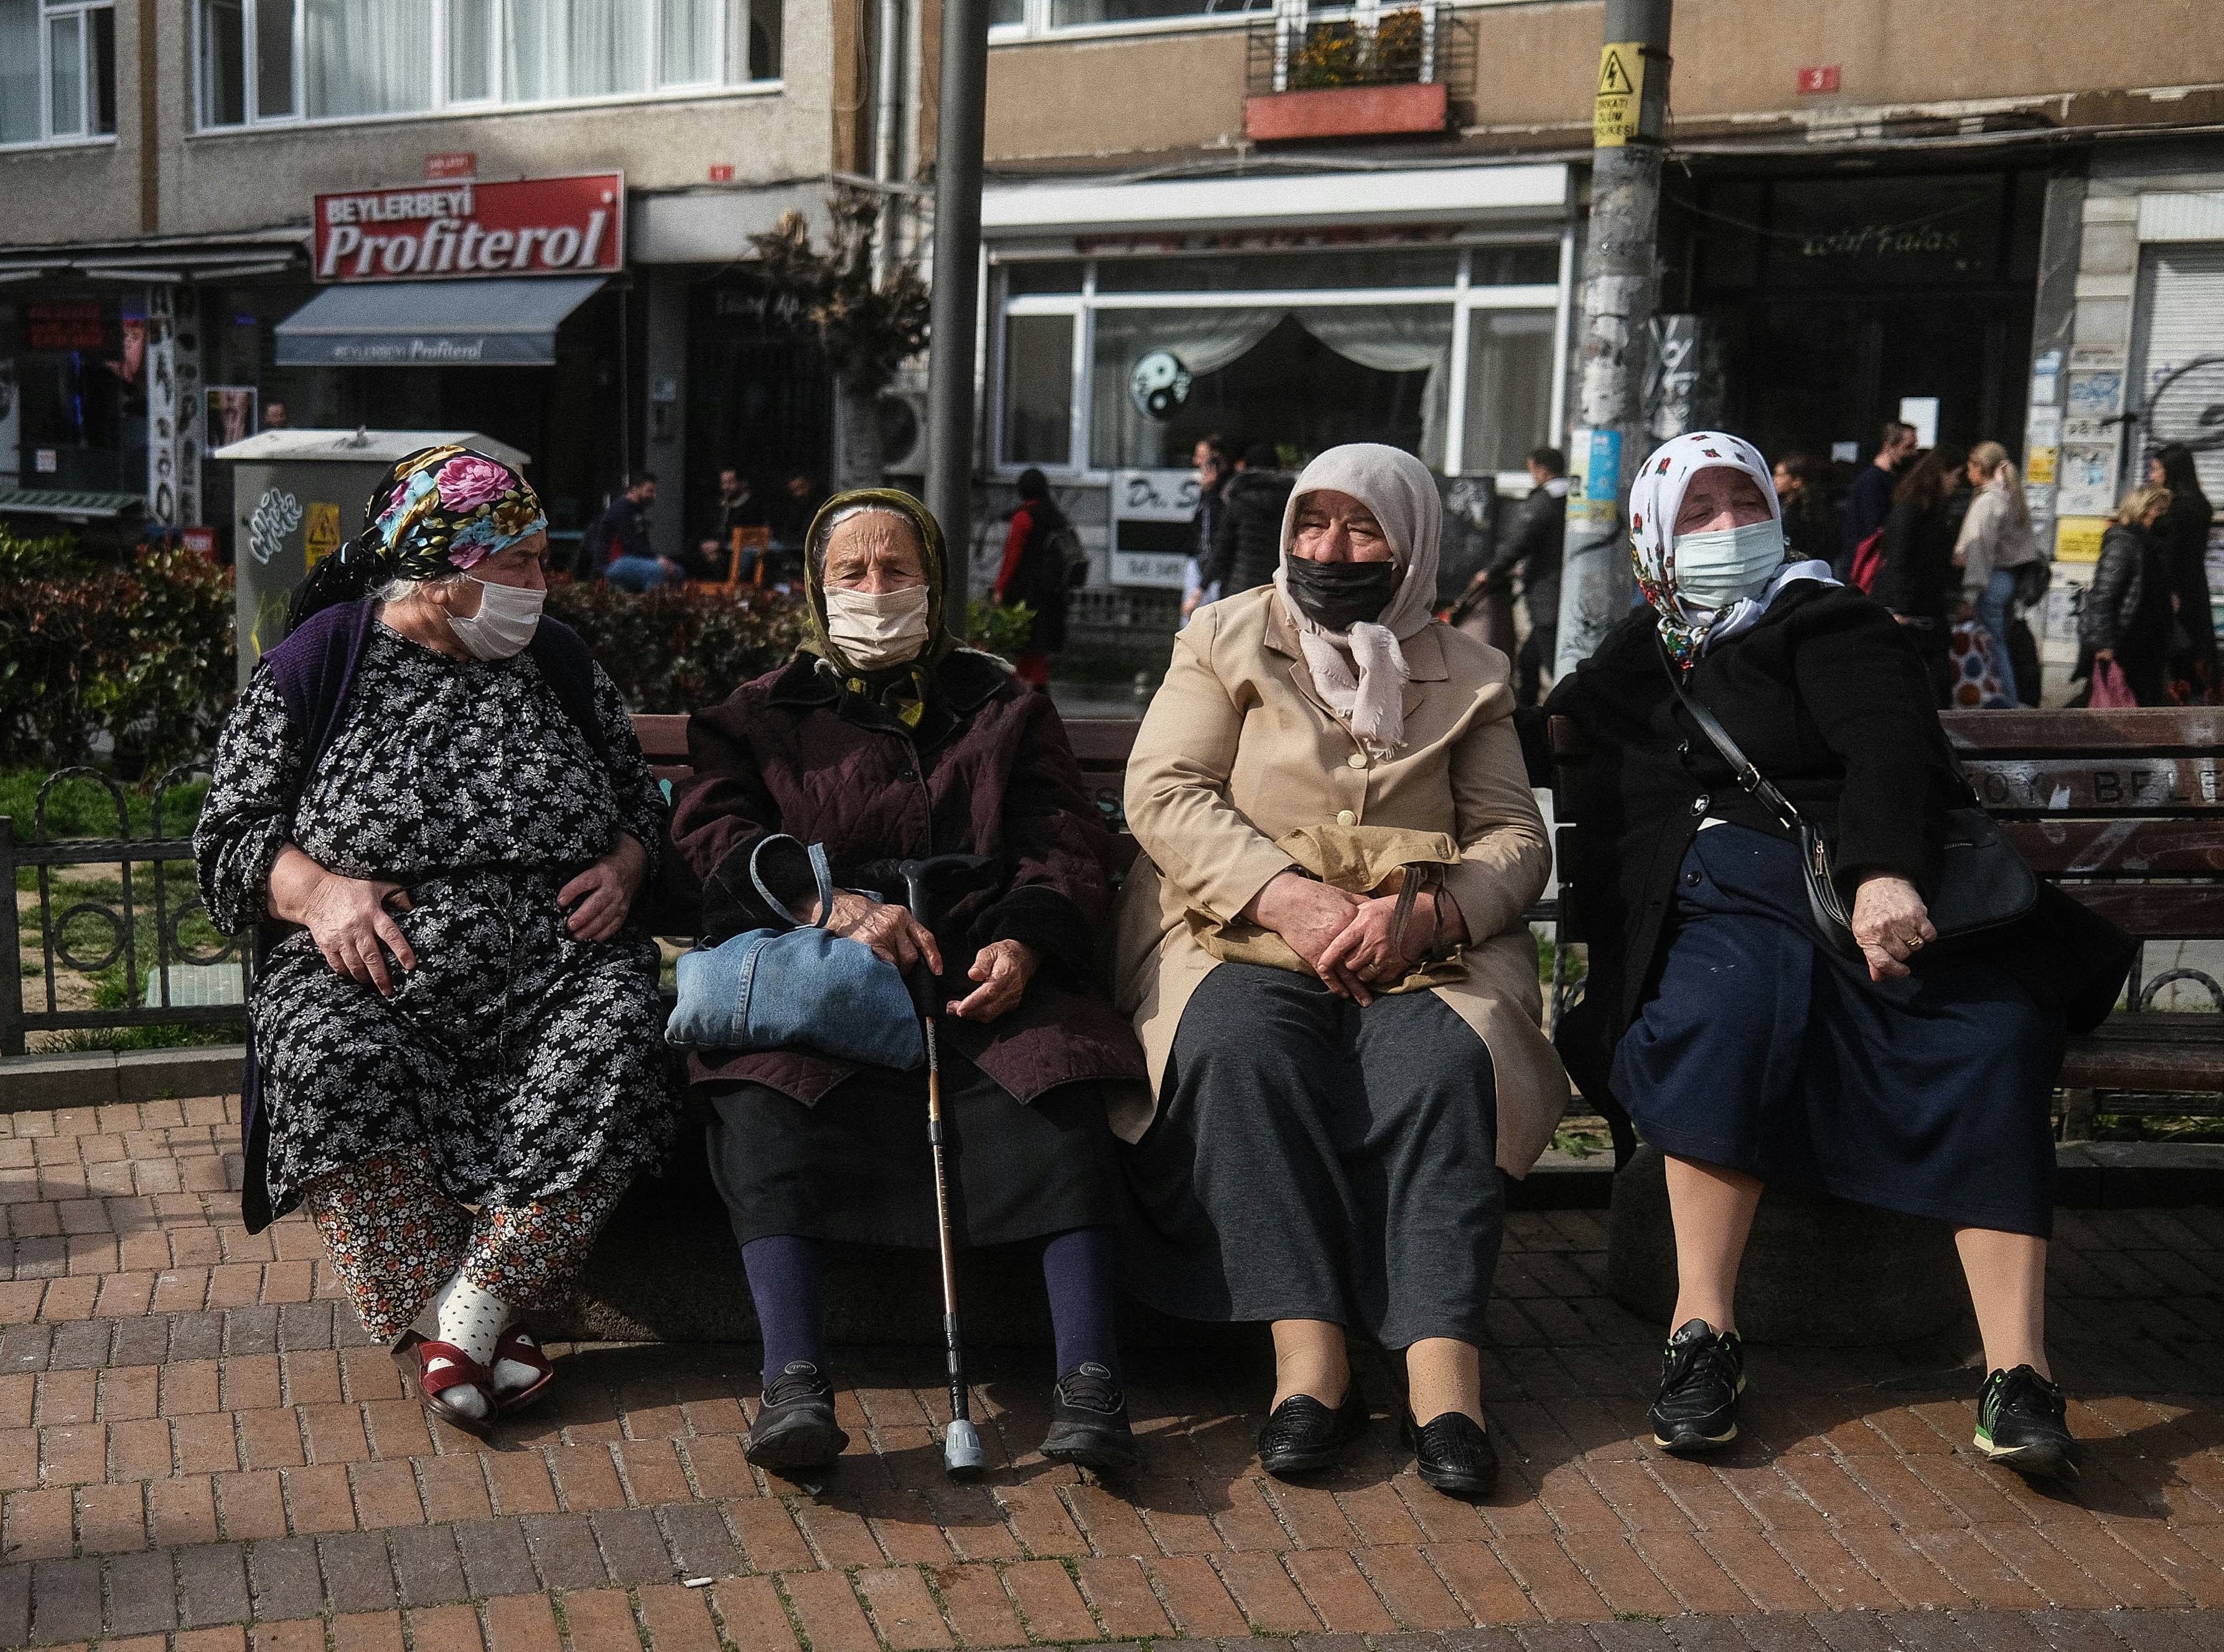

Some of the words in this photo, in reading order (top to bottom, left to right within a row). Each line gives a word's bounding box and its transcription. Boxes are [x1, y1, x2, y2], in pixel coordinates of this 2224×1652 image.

[320, 210, 607, 276] Profiterol
[410, 338, 484, 360] Profiterol
[1128, 478, 1166, 508] Dr.
